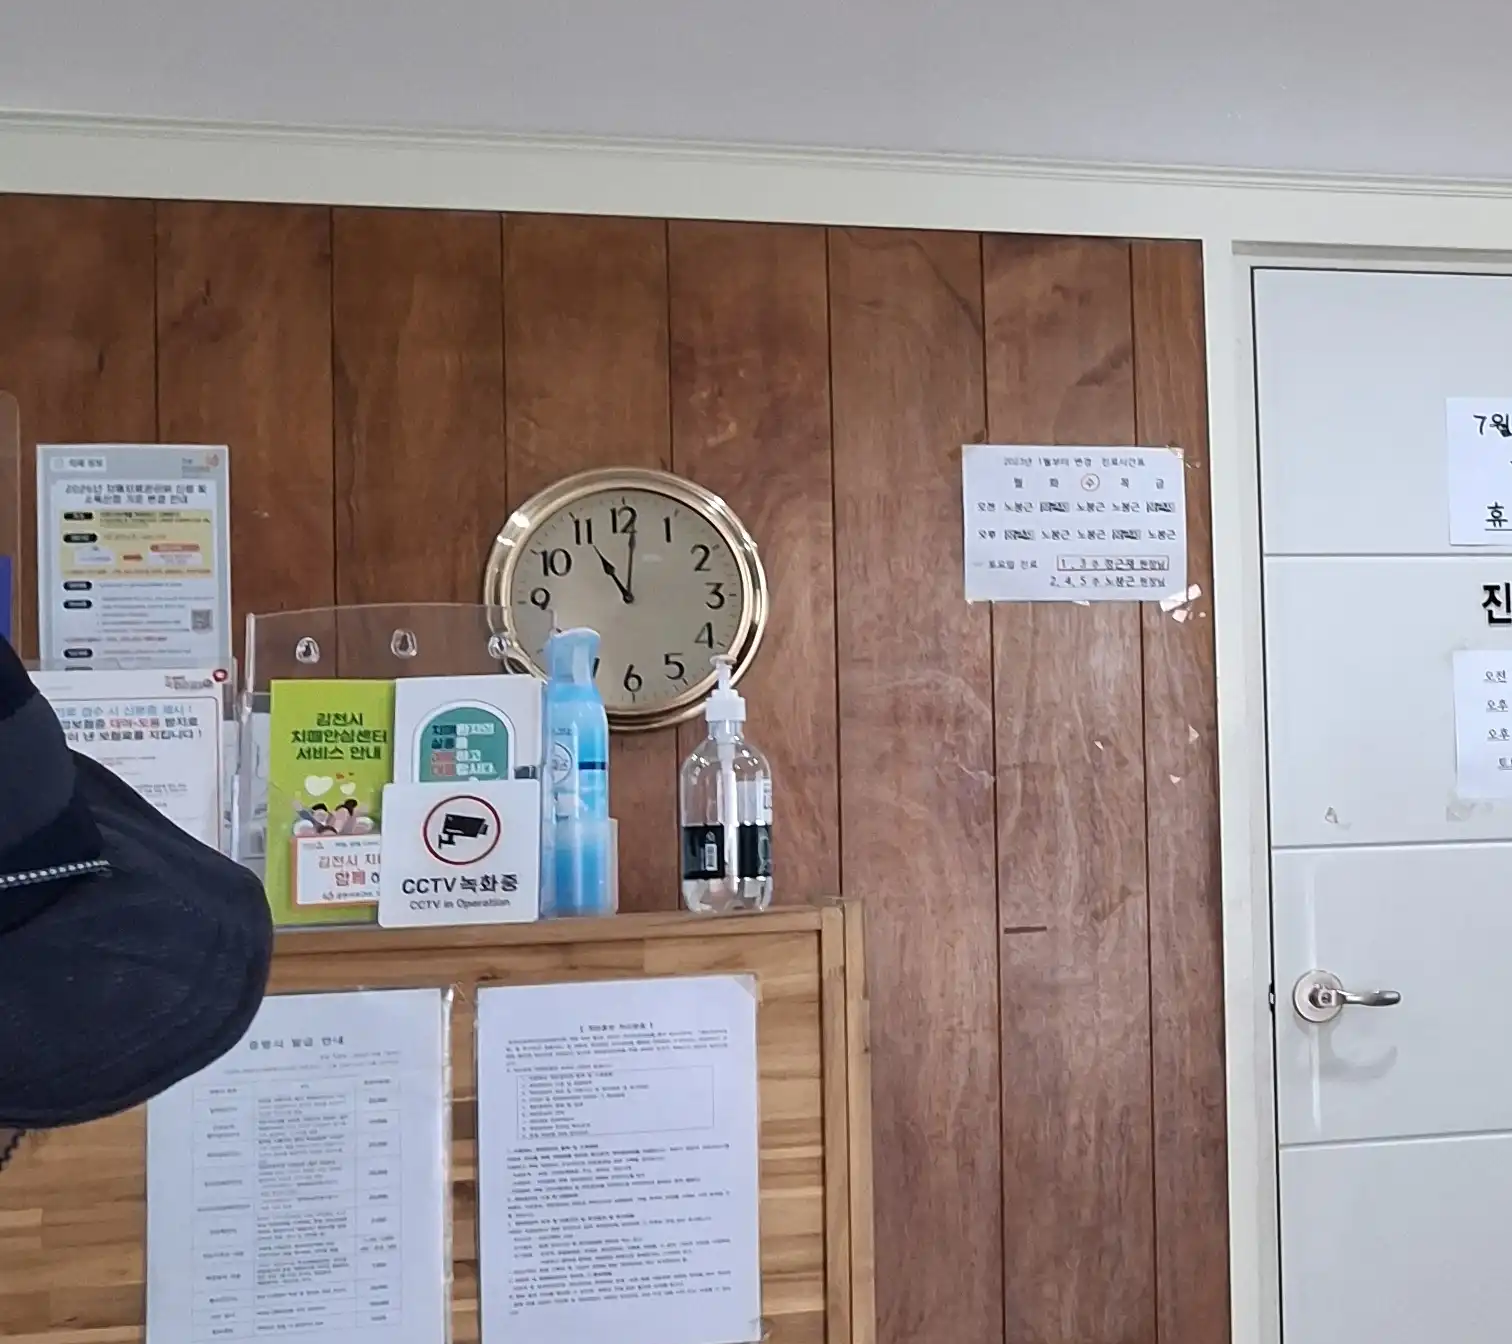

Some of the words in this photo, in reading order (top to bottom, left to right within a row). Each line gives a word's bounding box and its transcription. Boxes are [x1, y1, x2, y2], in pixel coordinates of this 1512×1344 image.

[610, 506, 637, 534] 12
[1486, 501, 1508, 528] 휴
[574, 518, 593, 545] 11
[664, 517, 671, 543] 1
[541, 548, 572, 576] 10
[691, 544, 711, 572] 2
[531, 588, 550, 610] 9
[706, 582, 725, 609] 3
[694, 622, 713, 648] 4
[623, 664, 643, 692] 6
[664, 653, 685, 680] 5
[316, 712, 363, 727] 김천시
[291, 729, 387, 744] 치매안심센터
[296, 746, 344, 760] 서비스
[349, 746, 382, 760] 안내
[402, 878, 457, 895] CCTV
[460, 874, 518, 892] 녹화중
[410, 900, 441, 910] CCTV
[444, 898, 454, 908] in
[457, 898, 511, 910] Operation
